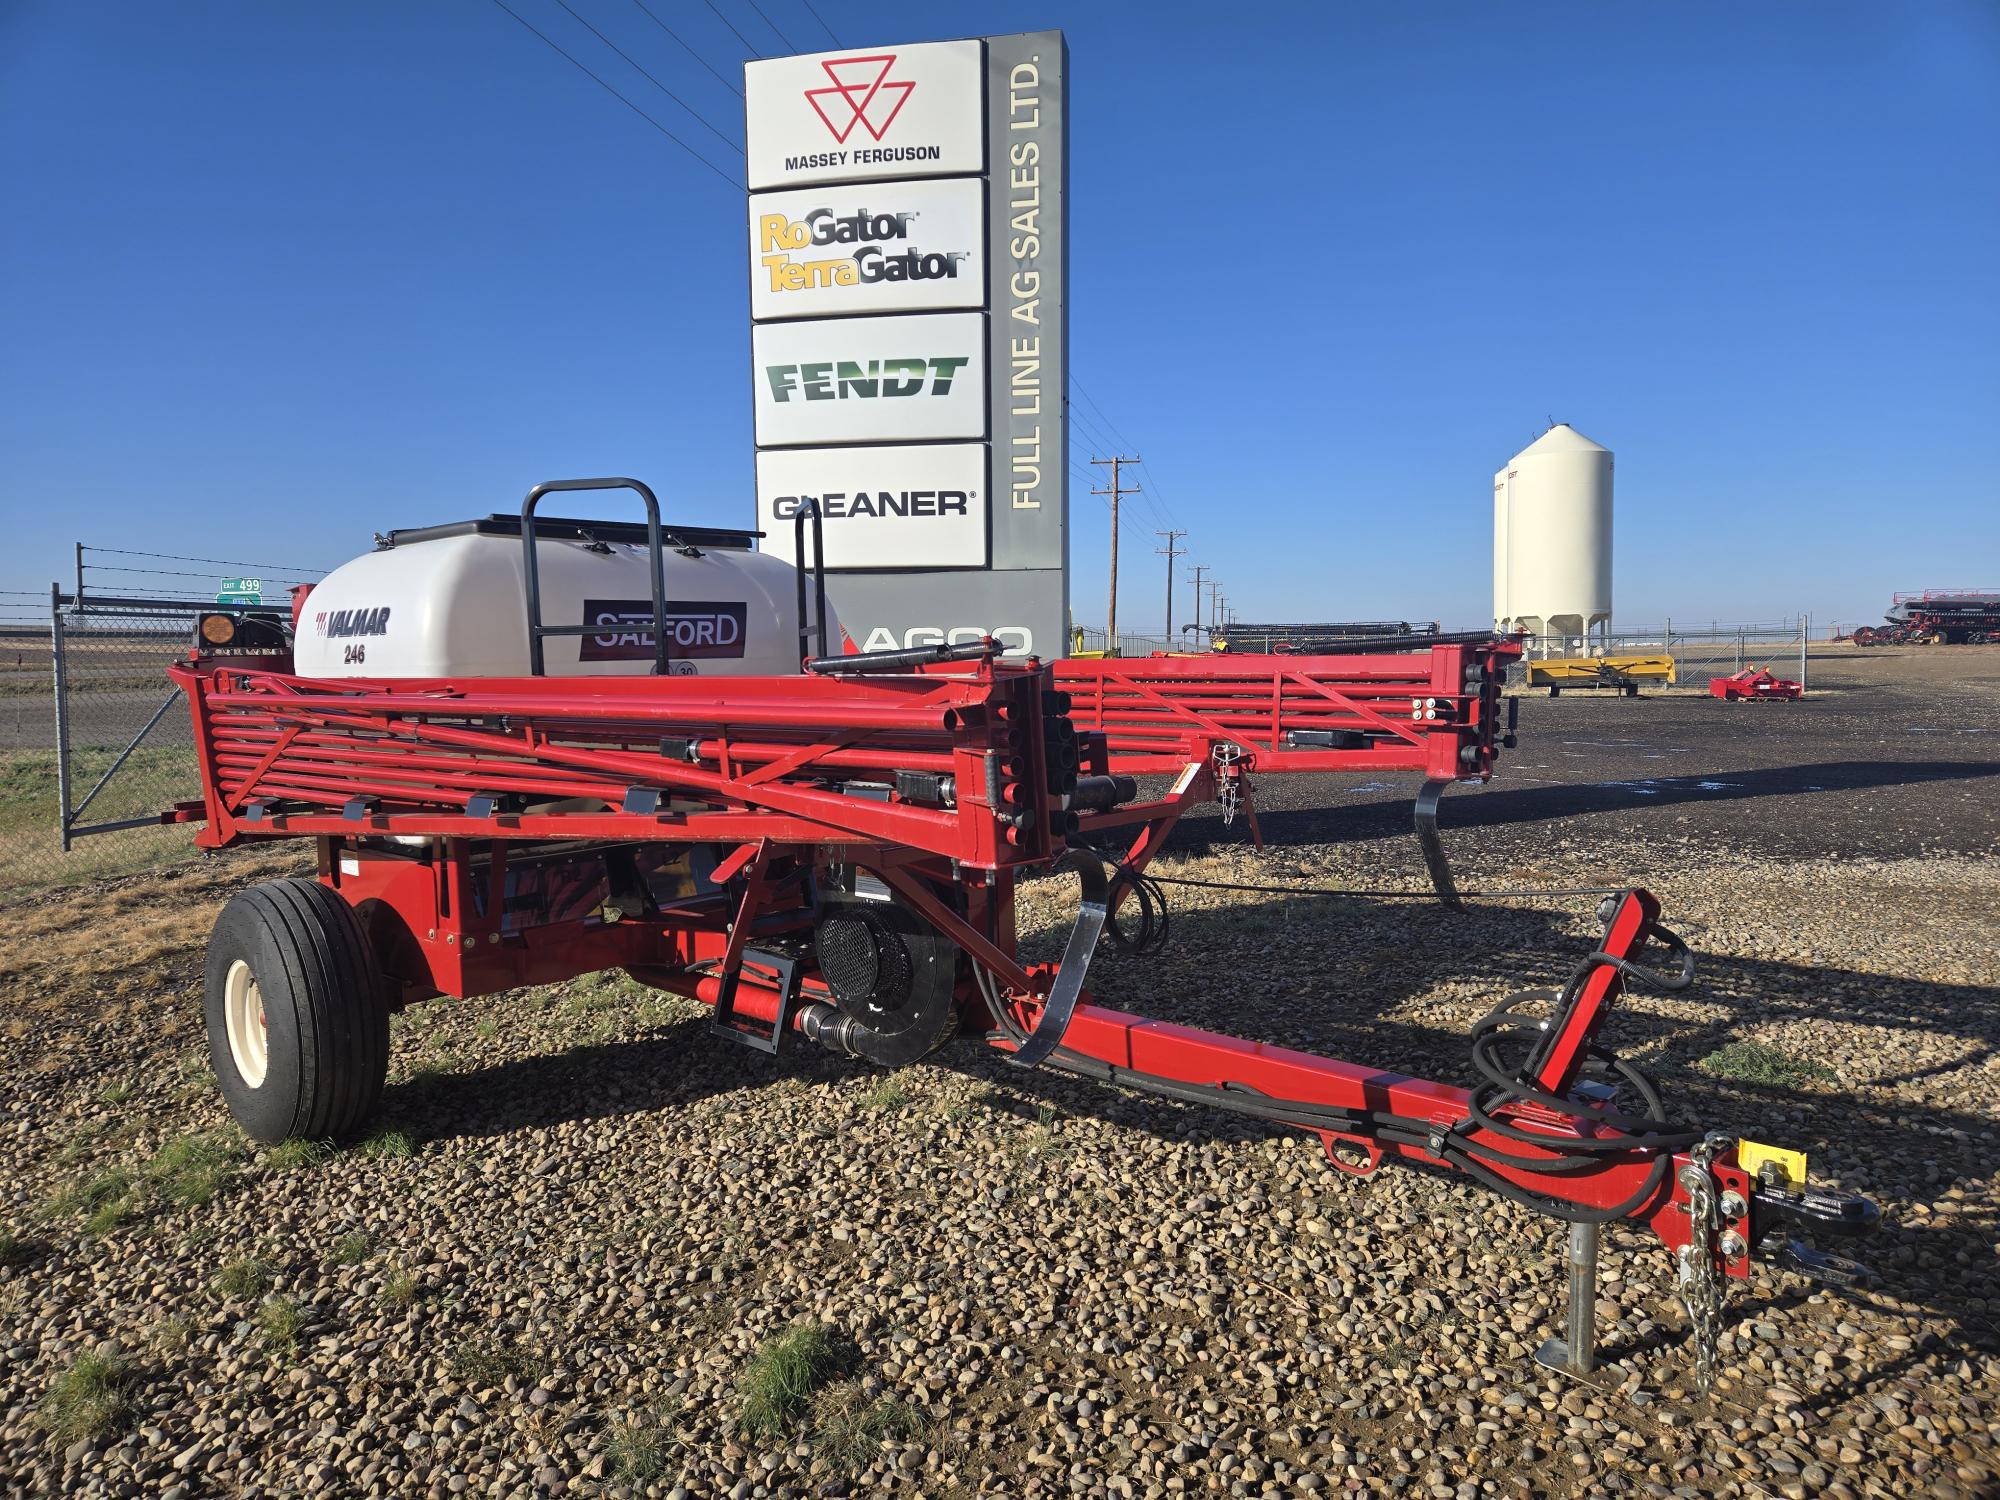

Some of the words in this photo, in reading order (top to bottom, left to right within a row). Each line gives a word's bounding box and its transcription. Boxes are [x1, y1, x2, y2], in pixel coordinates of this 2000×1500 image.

[1010, 55, 1039, 130] LTD.
[785, 151, 848, 171] MASSEY
[853, 146, 940, 164] FERGUSON
[1010, 141, 1040, 259] SALES
[760, 208, 916, 252] RoGator
[762, 246, 966, 293] TerraGator
[1010, 271, 1040, 326] AG
[765, 356, 970, 403] FENDT
[1011, 336, 1040, 415] LINE
[1011, 425, 1041, 509] FULL
[240, 579, 260, 591] 499
[326, 606, 391, 639] VALMAR
[344, 644, 365, 665] 246
